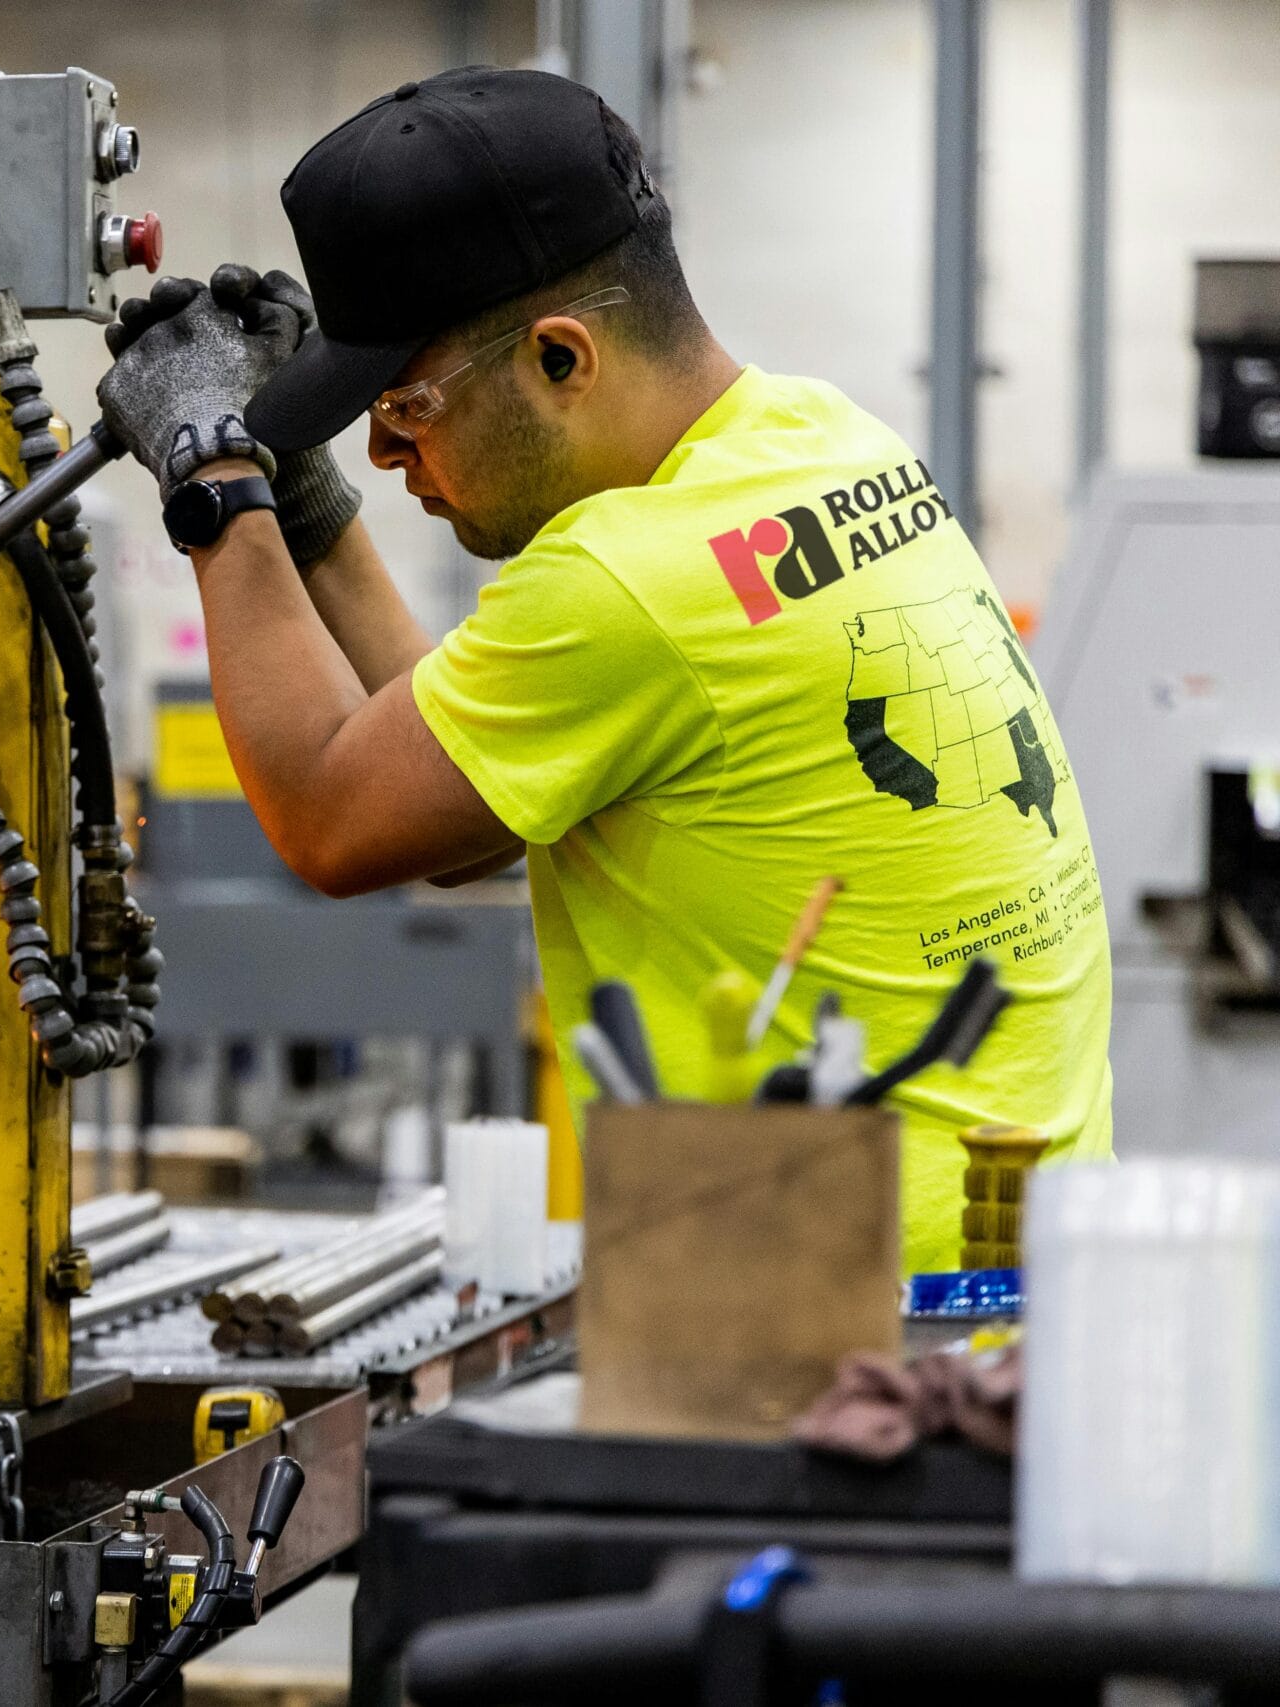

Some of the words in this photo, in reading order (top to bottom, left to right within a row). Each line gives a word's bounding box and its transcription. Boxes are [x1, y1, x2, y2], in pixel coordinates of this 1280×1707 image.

[920, 927, 950, 948] Los
[956, 900, 1026, 935] Angeles,
[1028, 885, 1046, 904] CA
[923, 922, 1033, 970] Temperance,
[1035, 908, 1050, 928] MI
